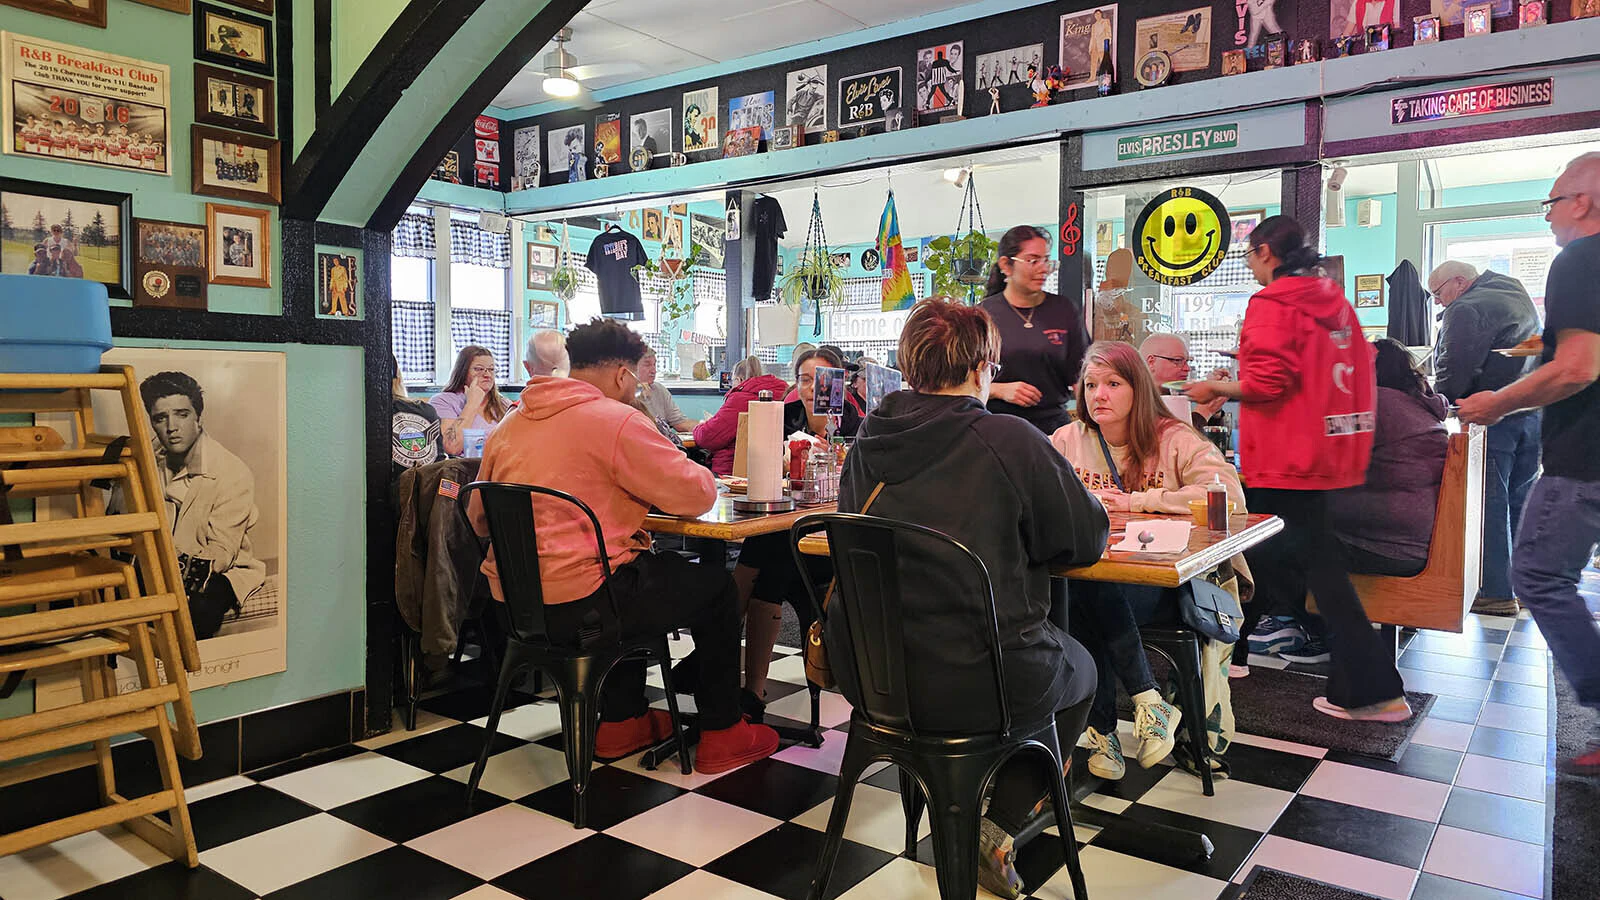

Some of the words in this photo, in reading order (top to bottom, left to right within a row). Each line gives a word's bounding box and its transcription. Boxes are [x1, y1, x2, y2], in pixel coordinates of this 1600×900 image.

[1065, 23, 1092, 37] King
[20, 46, 52, 62] R&B
[57, 53, 124, 77] Breakfast
[129, 69, 158, 84] Club
[24, 61, 37, 69] The
[128, 82, 155, 92] Baseball
[33, 71, 49, 79] Club
[52, 74, 74, 84] THANK
[76, 79, 90, 87] YOU
[103, 85, 118, 93] your
[845, 81, 868, 105] Elvis
[50, 95, 78, 115] 20
[849, 103, 873, 120] R&B
[1409, 96, 1446, 118] TAKING
[1448, 91, 1476, 113] CARE
[1479, 89, 1496, 109] OF
[1495, 82, 1550, 107] BUSINESS
[1119, 141, 1141, 155] ELVIS
[1142, 129, 1213, 156] PRESLEY
[1213, 129, 1236, 144] BLVD
[1171, 187, 1192, 198] R&B
[1138, 256, 1193, 286] BREAKFAST
[1201, 250, 1225, 277] CLUB
[347, 255, 358, 315] ELVIS
[838, 313, 886, 337] Home
[204, 659, 240, 674] tonight
